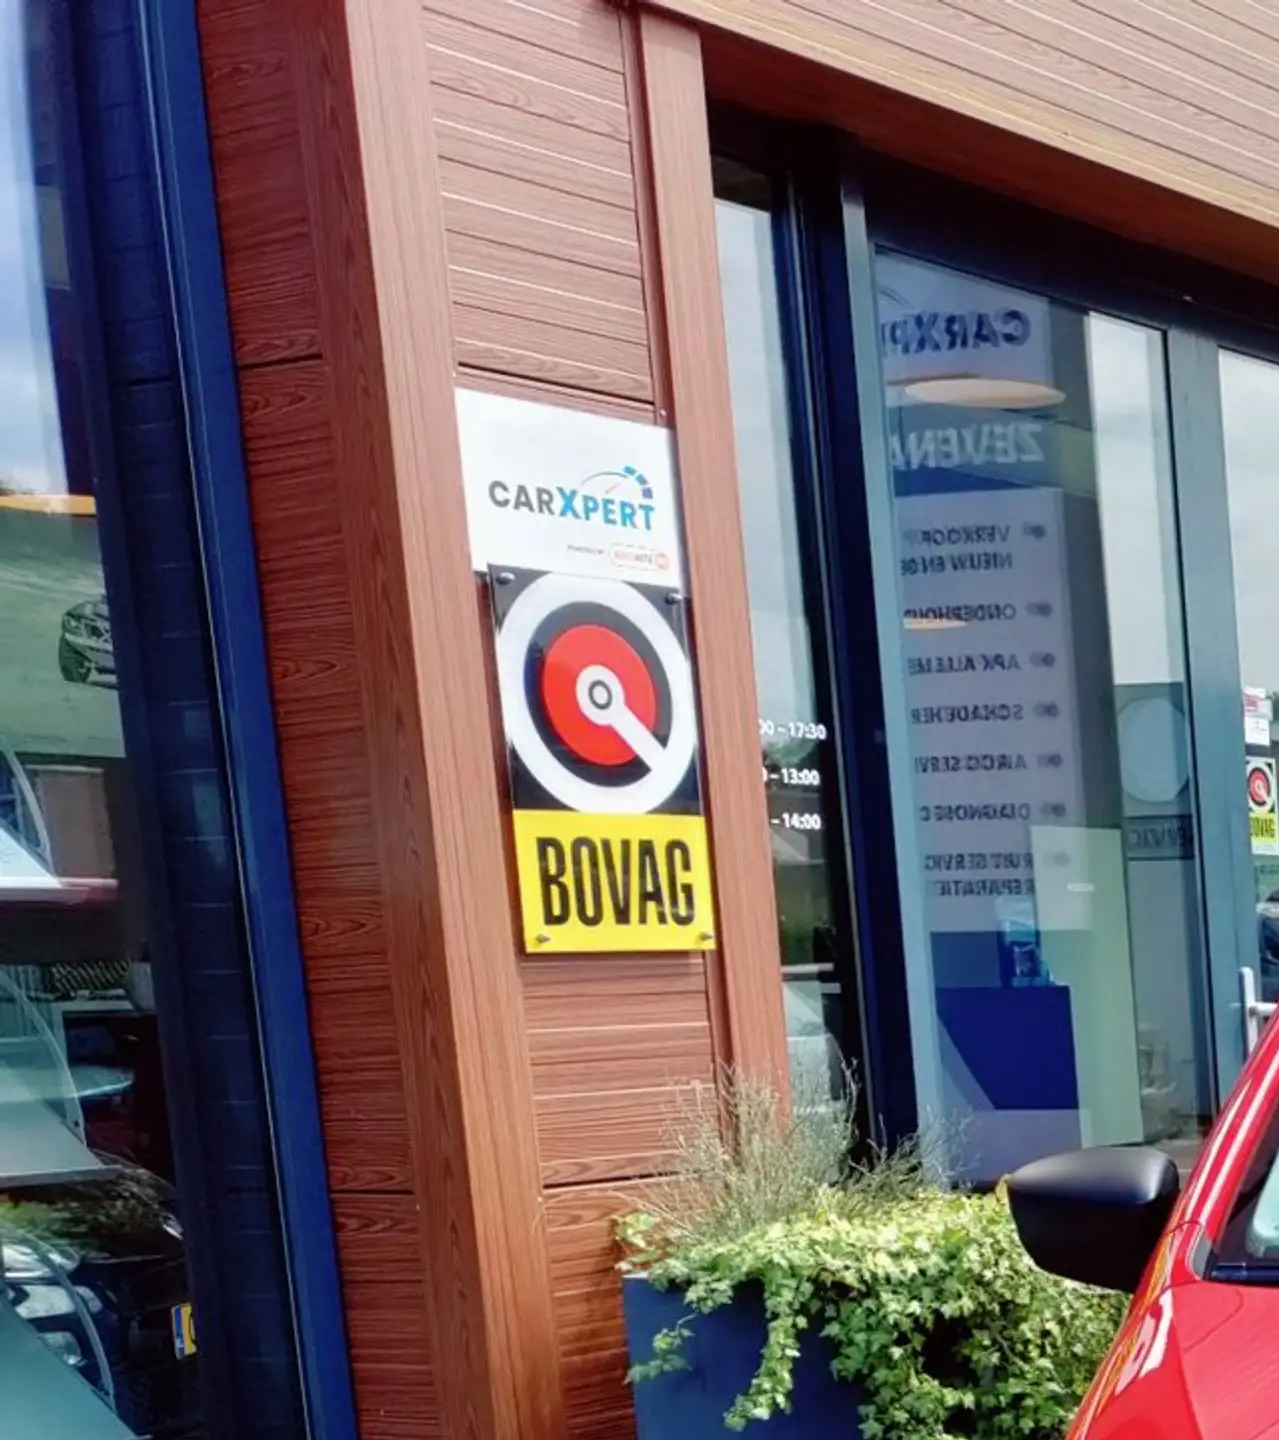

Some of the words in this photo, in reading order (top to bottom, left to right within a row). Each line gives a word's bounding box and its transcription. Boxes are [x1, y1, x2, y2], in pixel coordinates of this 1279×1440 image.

[487, 480, 656, 532] CARXPERT
[788, 722, 827, 739] 17:30
[536, 836, 696, 927] BOVAG
